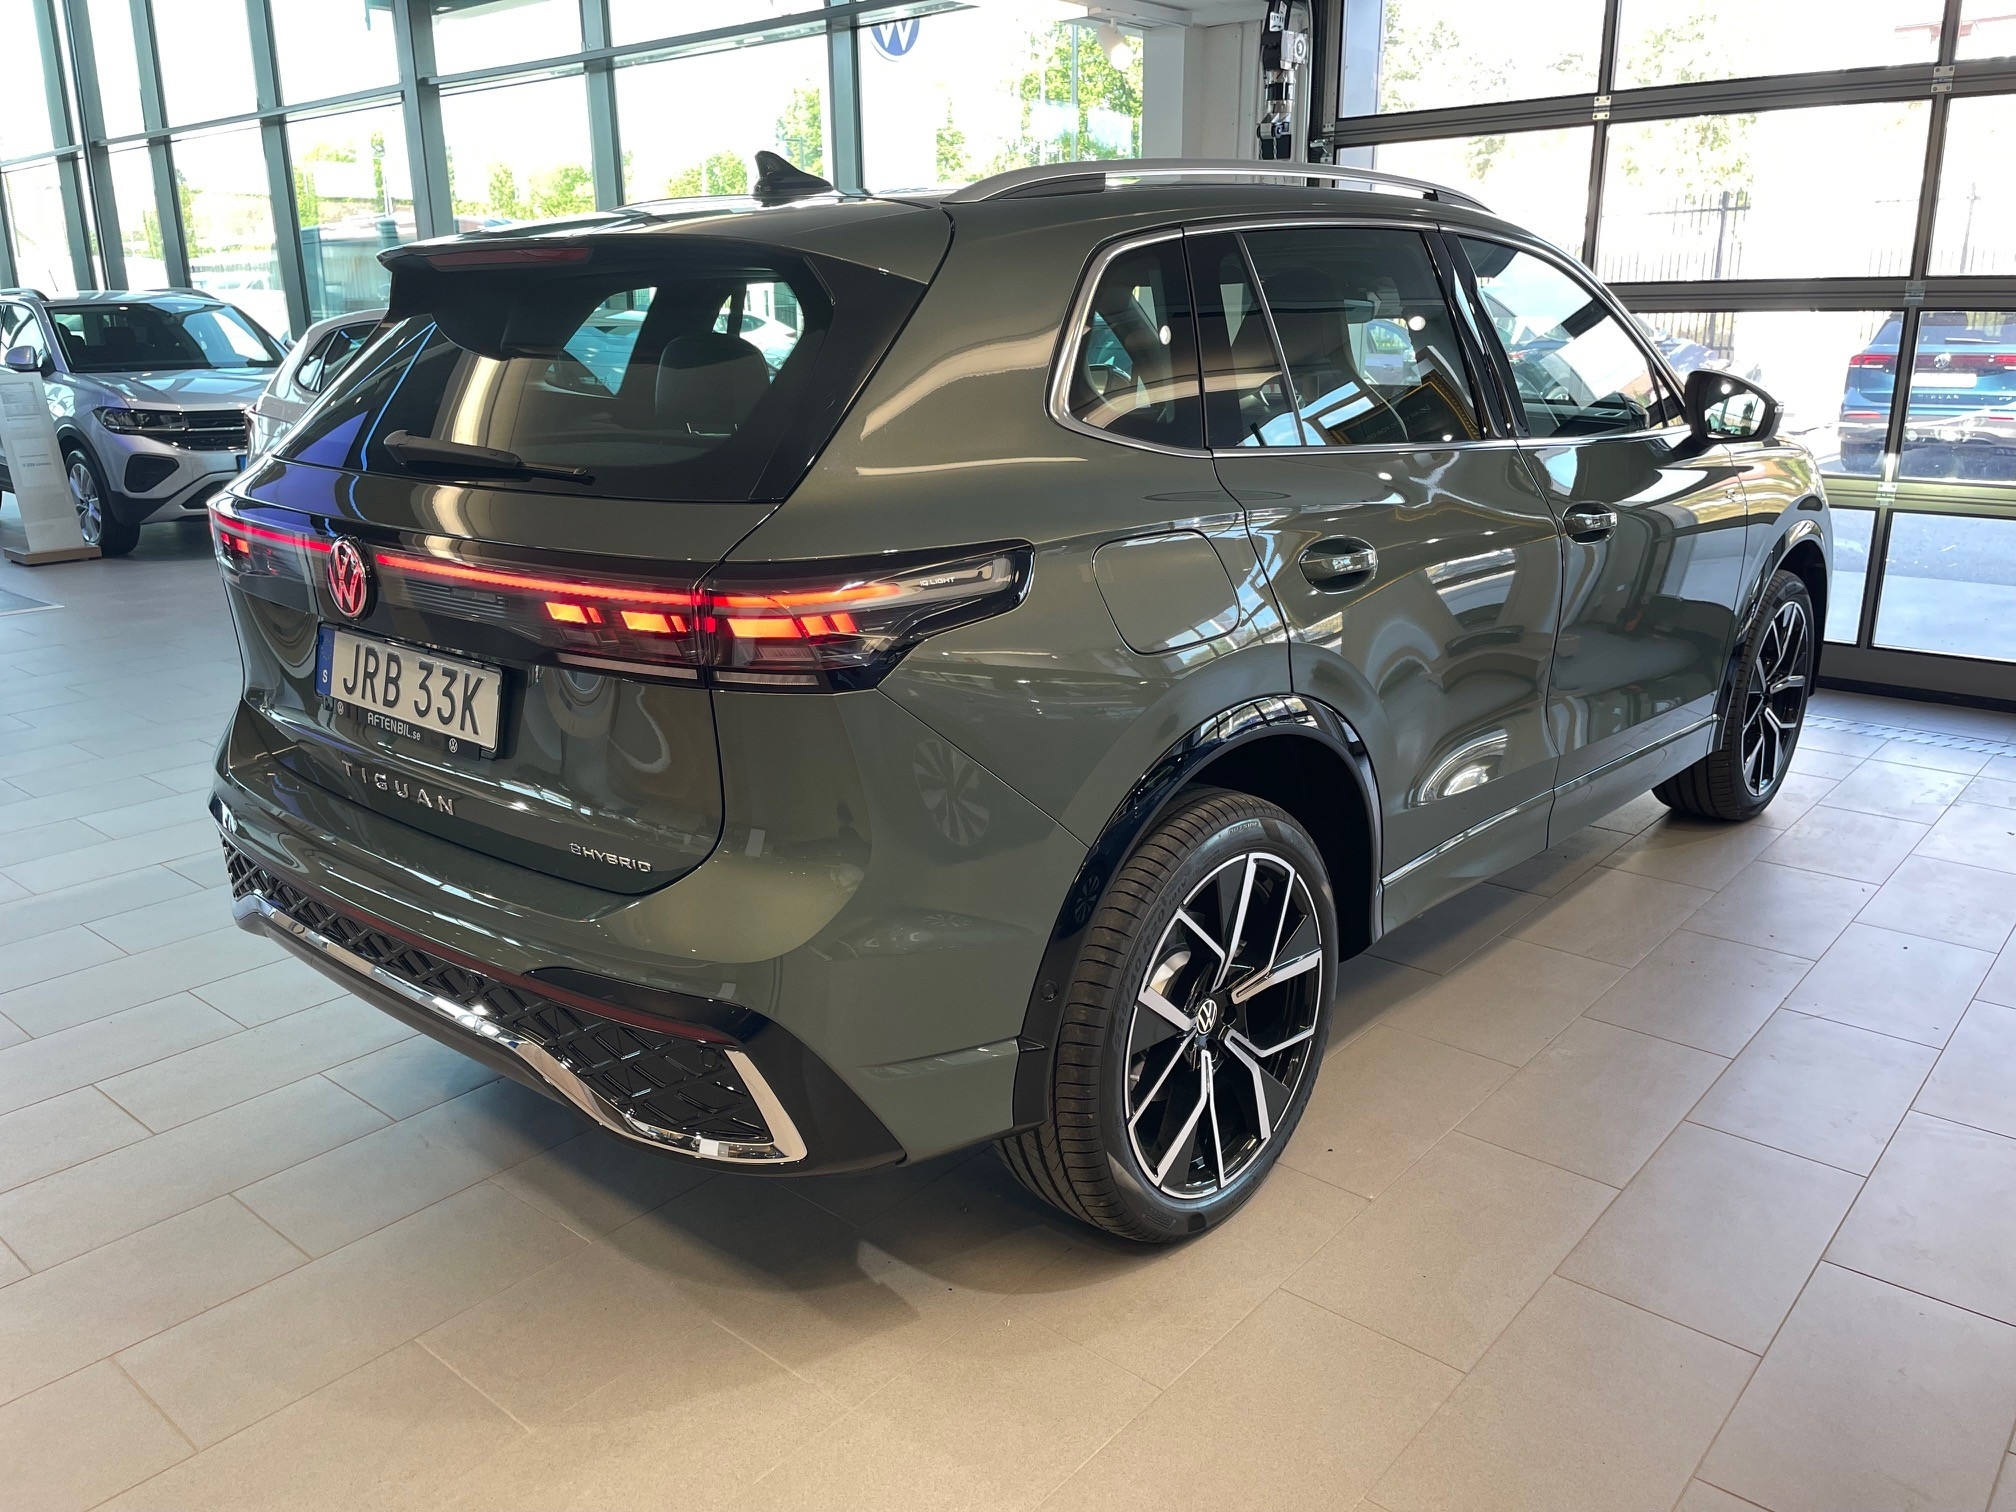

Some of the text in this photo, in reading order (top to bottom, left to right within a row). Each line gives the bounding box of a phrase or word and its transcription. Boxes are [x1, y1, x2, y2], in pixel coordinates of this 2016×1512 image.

[322, 669, 328, 683] S
[343, 643, 485, 736] JRB 33K
[367, 712, 421, 741] AFTENBIL.se
[340, 759, 455, 816] TIGUAN
